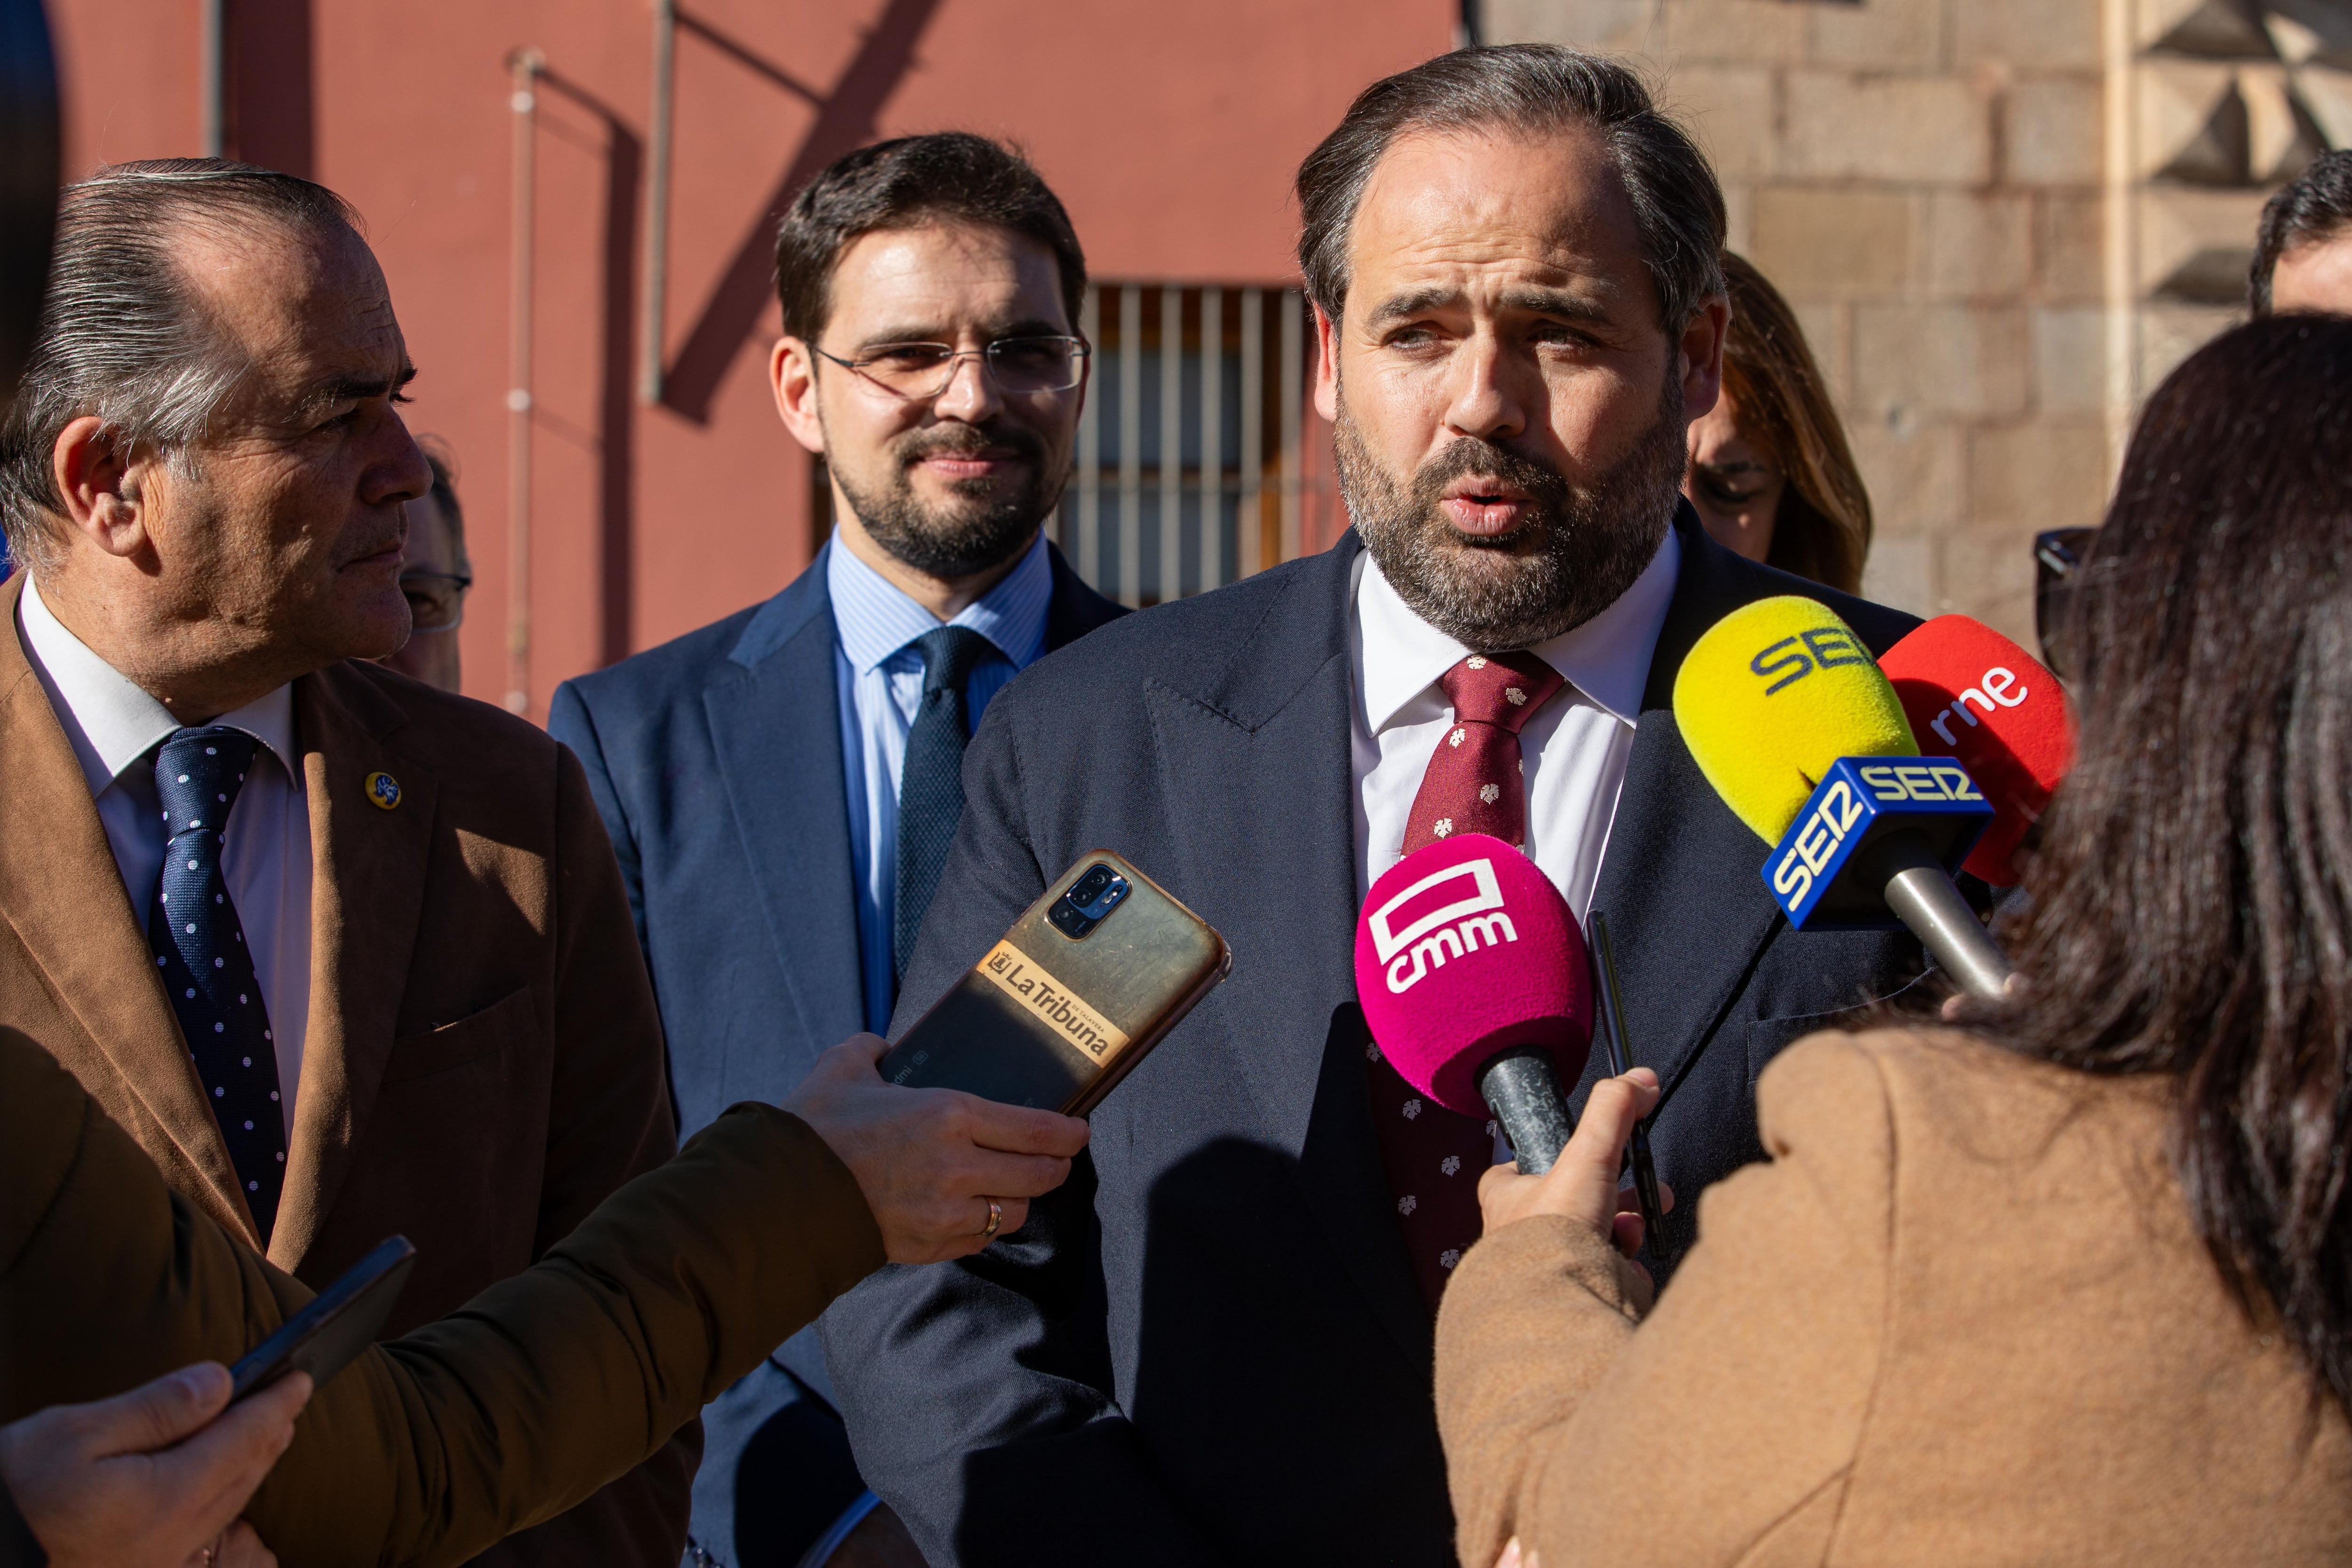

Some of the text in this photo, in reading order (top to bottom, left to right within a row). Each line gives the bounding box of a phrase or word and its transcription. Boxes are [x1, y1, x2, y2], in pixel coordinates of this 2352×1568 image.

[1750, 628, 1875, 696] SE
[1931, 667, 2027, 746] rne
[1860, 767, 1984, 800] SER
[1774, 781, 1863, 911] SER
[1386, 912, 1518, 994] cmm
[1006, 964, 1108, 1056] La Tribuna
[1079, 1011, 1104, 1033] TALAVERA
[894, 1065, 913, 1084] dmi
